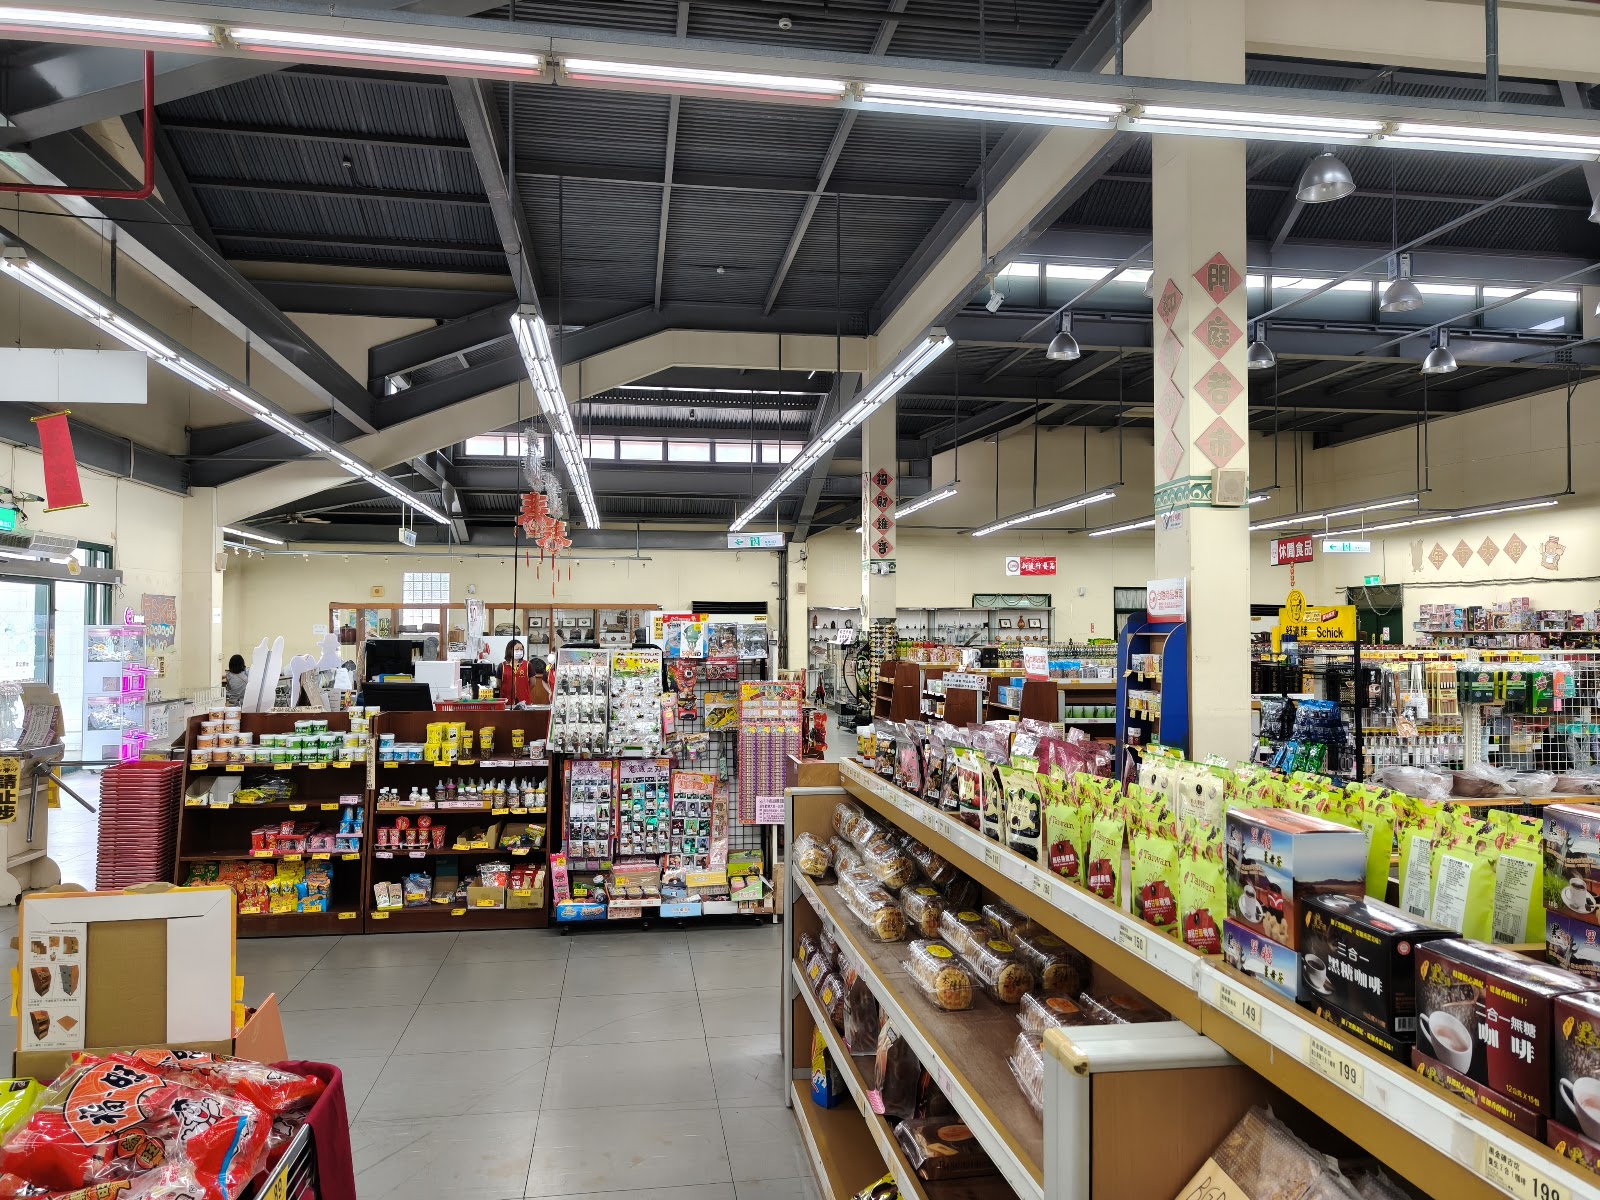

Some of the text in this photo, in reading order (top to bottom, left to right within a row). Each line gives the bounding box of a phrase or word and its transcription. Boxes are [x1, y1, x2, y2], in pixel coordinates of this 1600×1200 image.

[1316, 625, 1344, 639] Schick
[1051, 815, 1075, 830] Taiwan
[1143, 849, 1172, 868] Taiwan
[1190, 872, 1216, 894] Taiwan
[1134, 935, 1143, 950] 150
[1337, 941, 1370, 962] 三合一
[1242, 1002, 1256, 1022] 149
[1339, 1061, 1357, 1085] 199
[1532, 1178, 1560, 1200] 199
